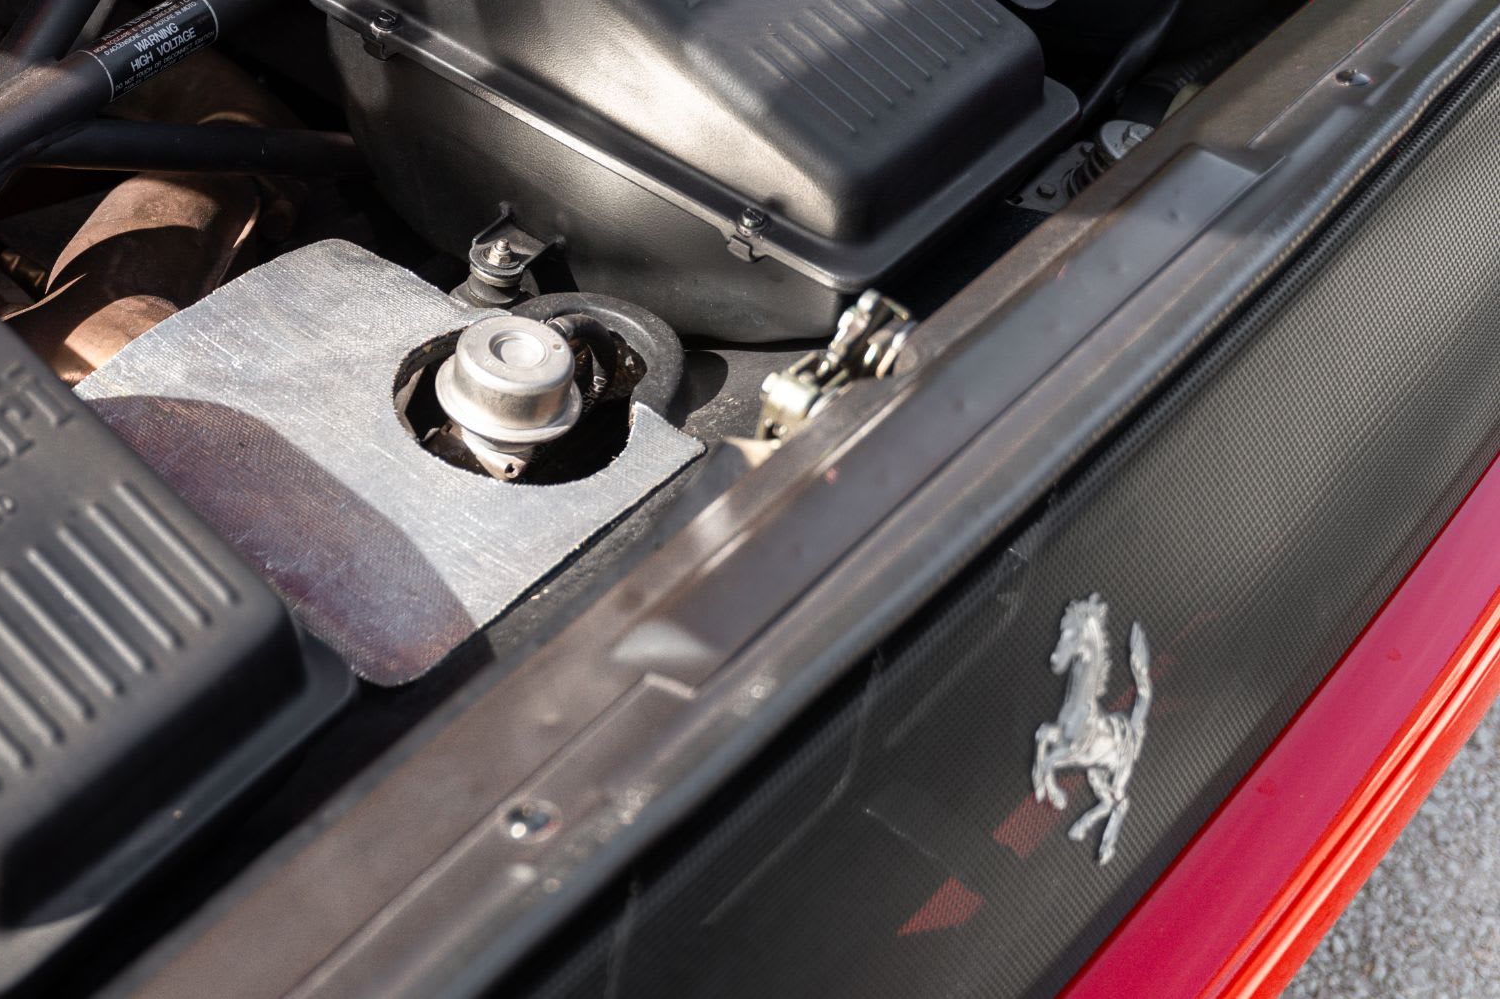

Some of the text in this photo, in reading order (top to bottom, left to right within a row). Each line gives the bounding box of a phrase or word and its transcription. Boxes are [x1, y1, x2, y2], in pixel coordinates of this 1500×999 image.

[134, 22, 179, 53] WARNING
[141, 26, 154, 35] CON
[130, 52, 154, 72] HIGH
[156, 27, 197, 57] VOLTAGE
